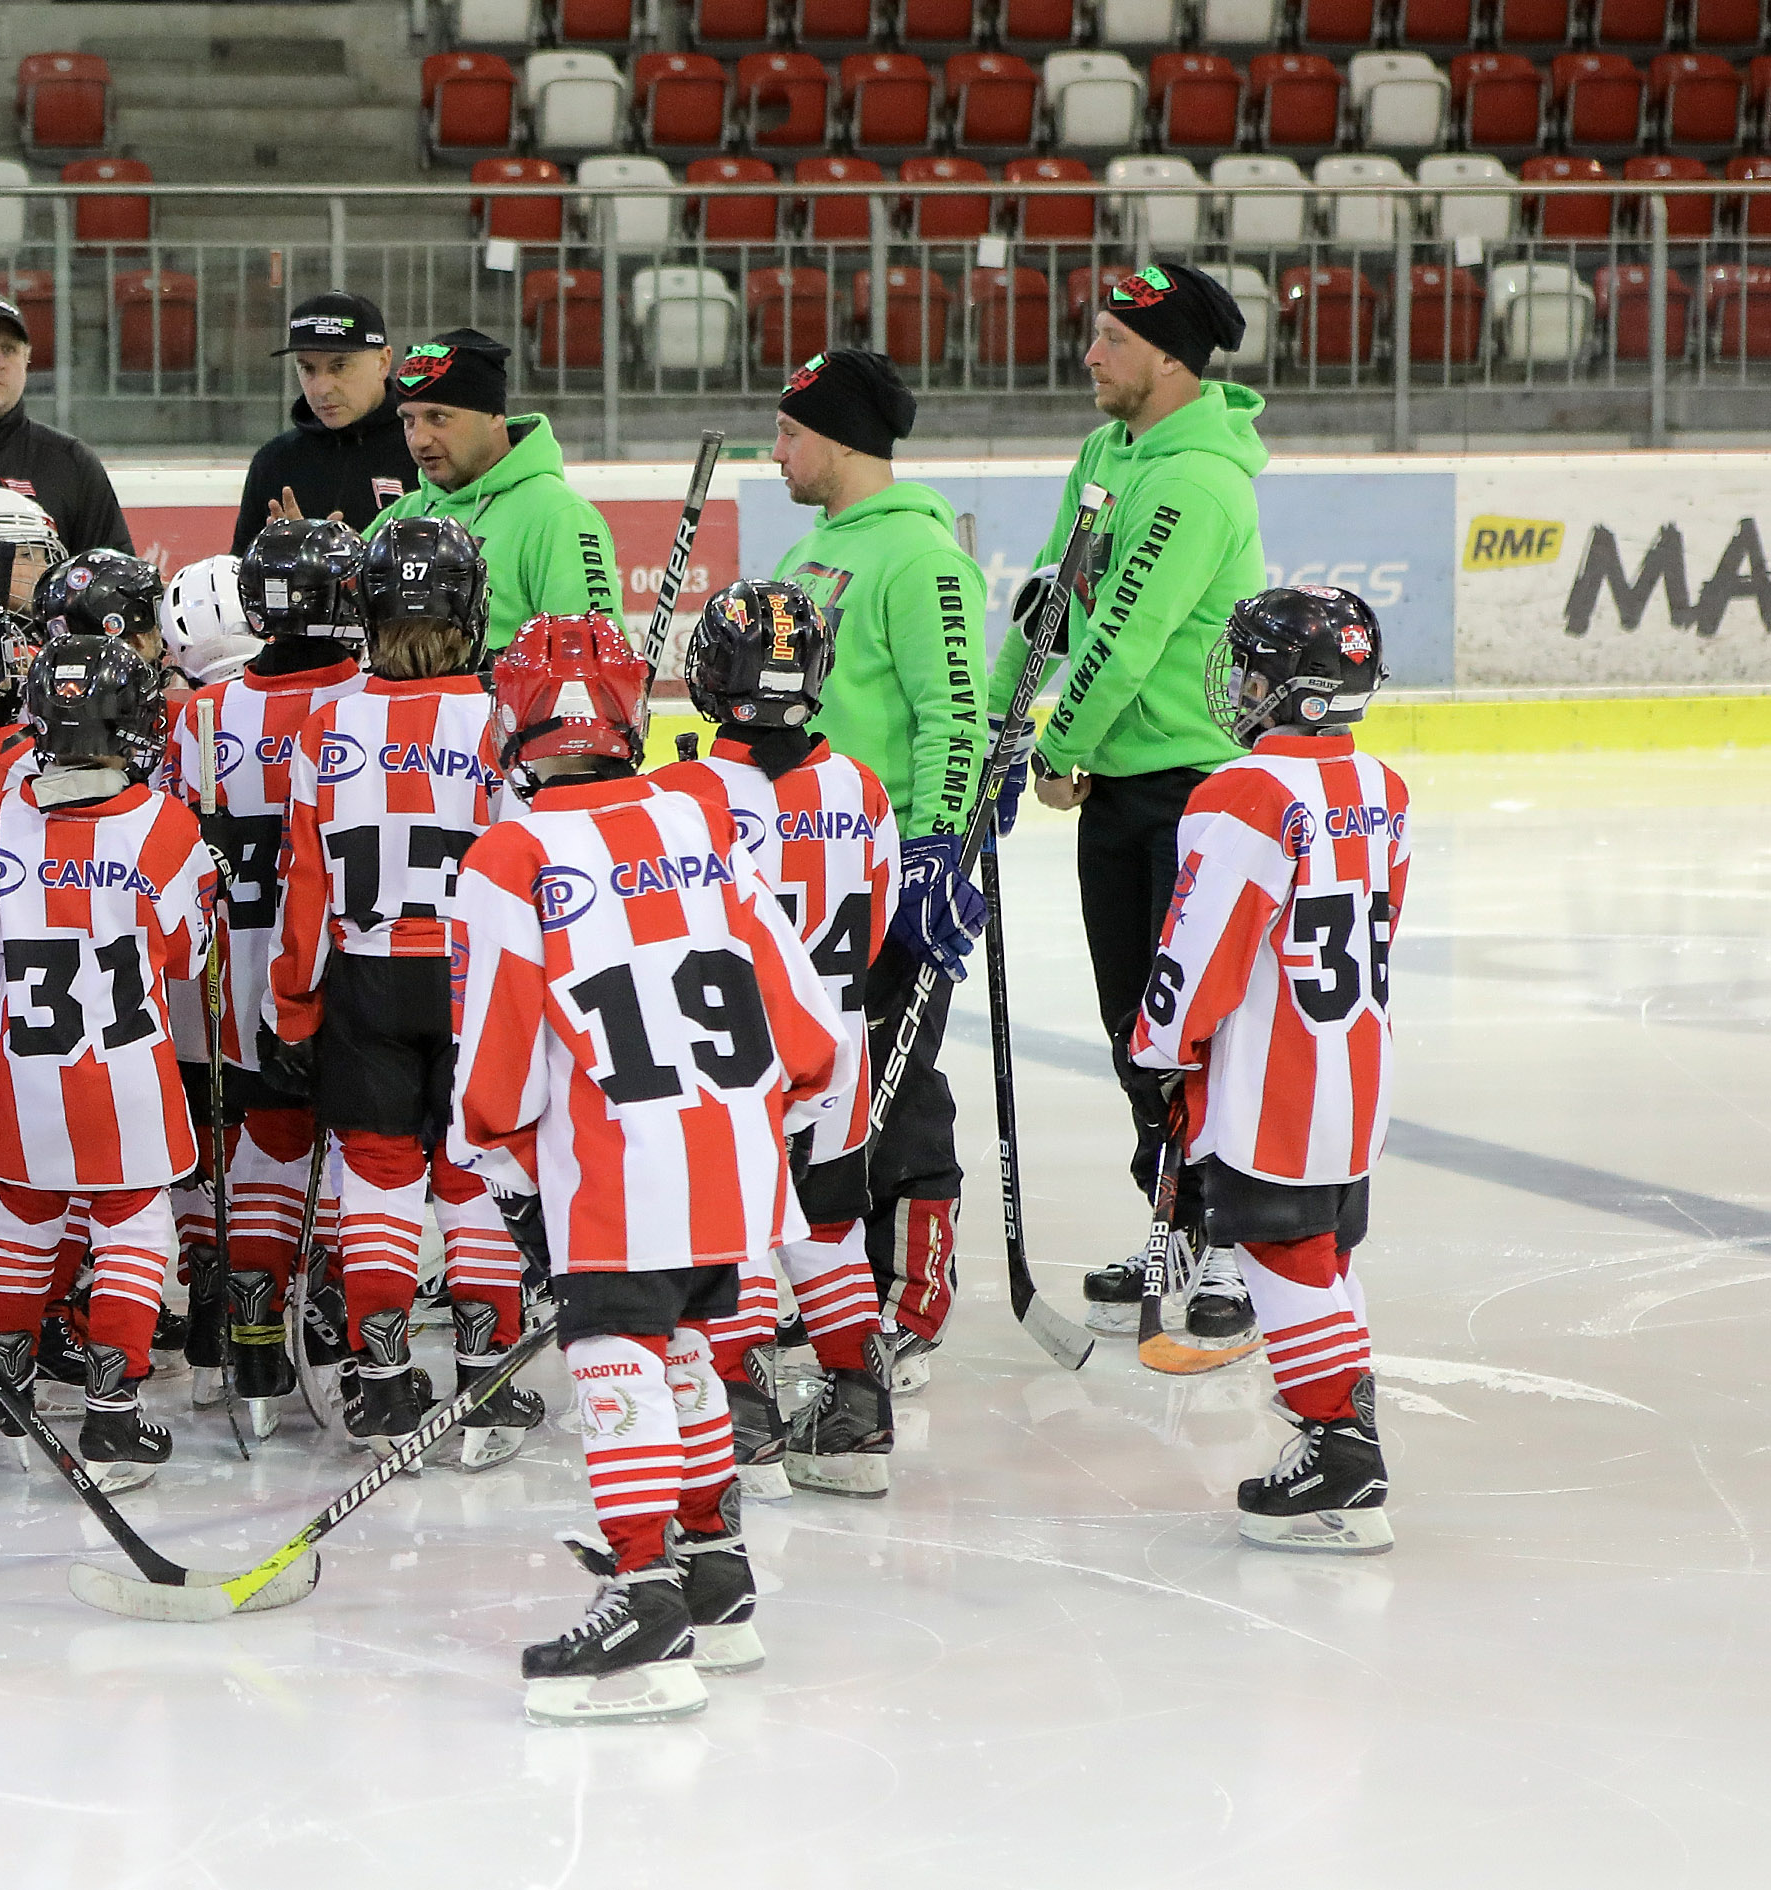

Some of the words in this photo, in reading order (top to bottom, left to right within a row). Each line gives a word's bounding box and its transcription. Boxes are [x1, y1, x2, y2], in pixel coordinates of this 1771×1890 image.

[401, 562, 428, 581] 87
[1099, 505, 1182, 640] HOKEJOVY
[1472, 528, 1559, 562] RMF
[645, 516, 699, 669] BAUER
[768, 594, 789, 619] Red
[773, 616, 795, 660] Bull
[3, 934, 158, 1057] 31
[570, 948, 776, 1107] 19
[1144, 952, 1185, 1027] 6
[997, 1138, 1020, 1241] BAUER
[1143, 1221, 1170, 1298] BAUER
[30, 1411, 62, 1454] VAPOR
[70, 1467, 91, 1491] 90
[327, 1391, 476, 1524] WARRIOR
